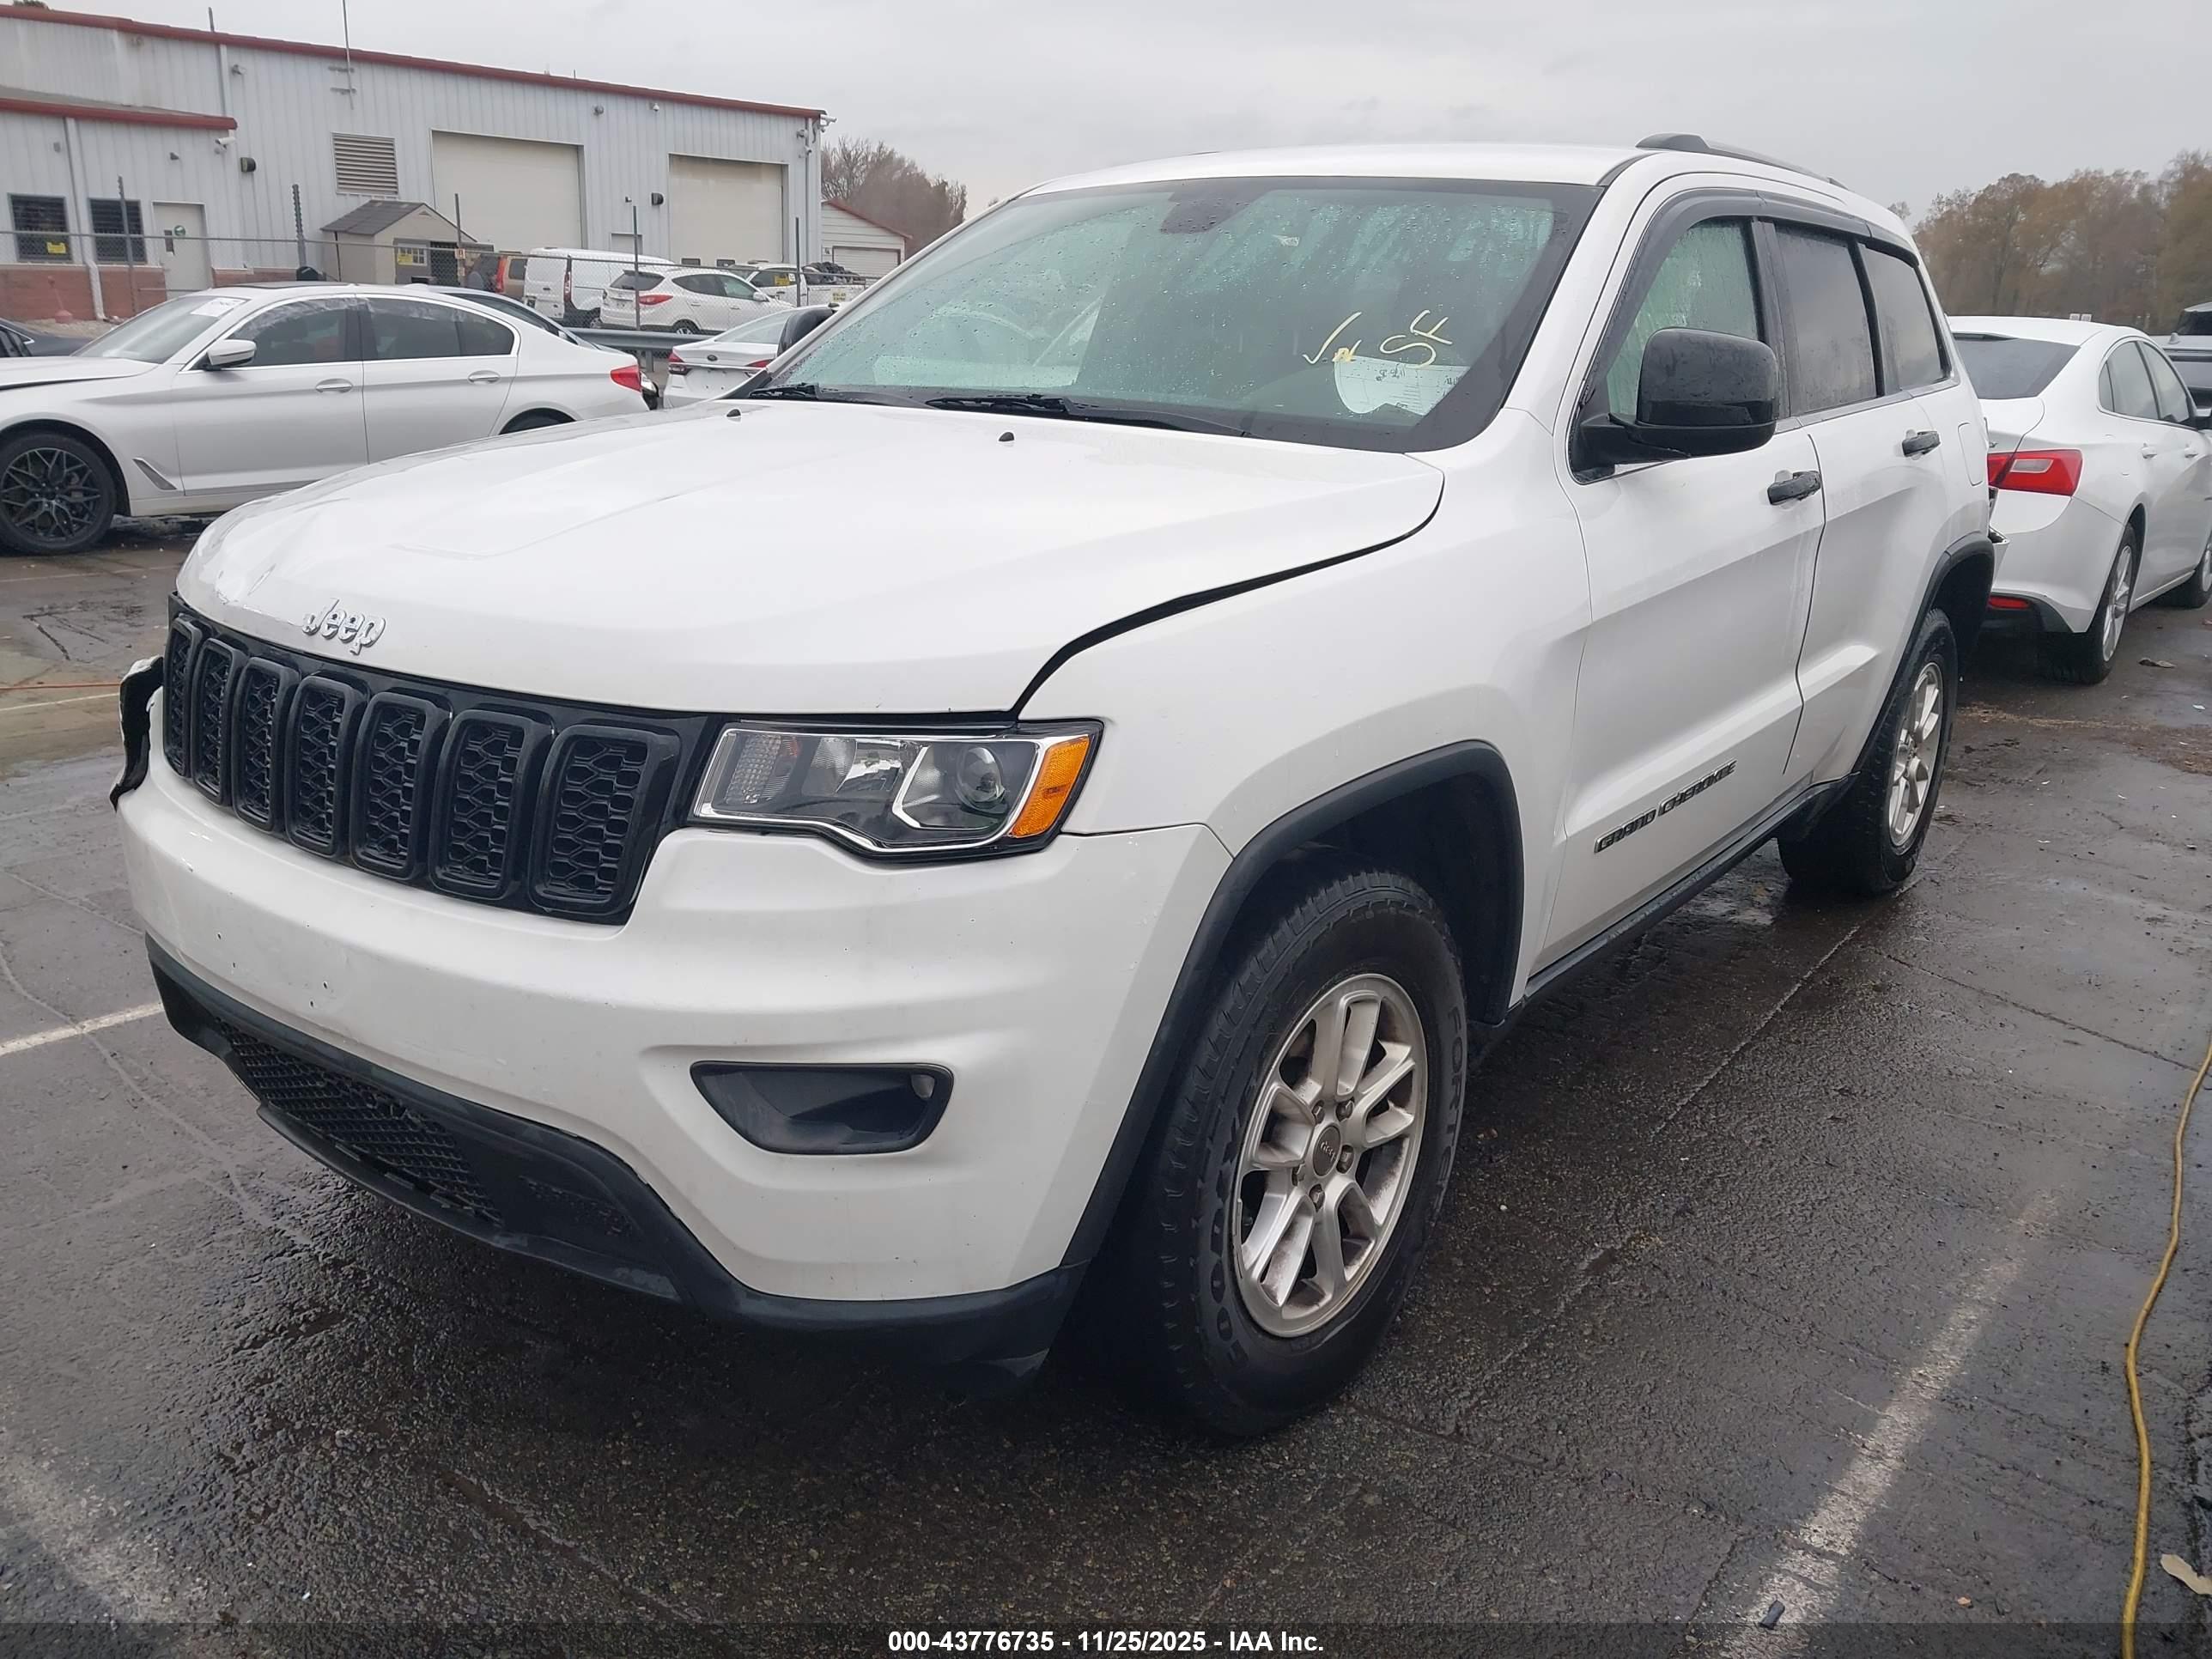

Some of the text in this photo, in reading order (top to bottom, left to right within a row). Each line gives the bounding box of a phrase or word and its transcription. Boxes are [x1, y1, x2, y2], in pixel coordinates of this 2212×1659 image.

[302, 598, 386, 656] Jeep
[1594, 758, 1738, 854] GRAND CHEROKEE
